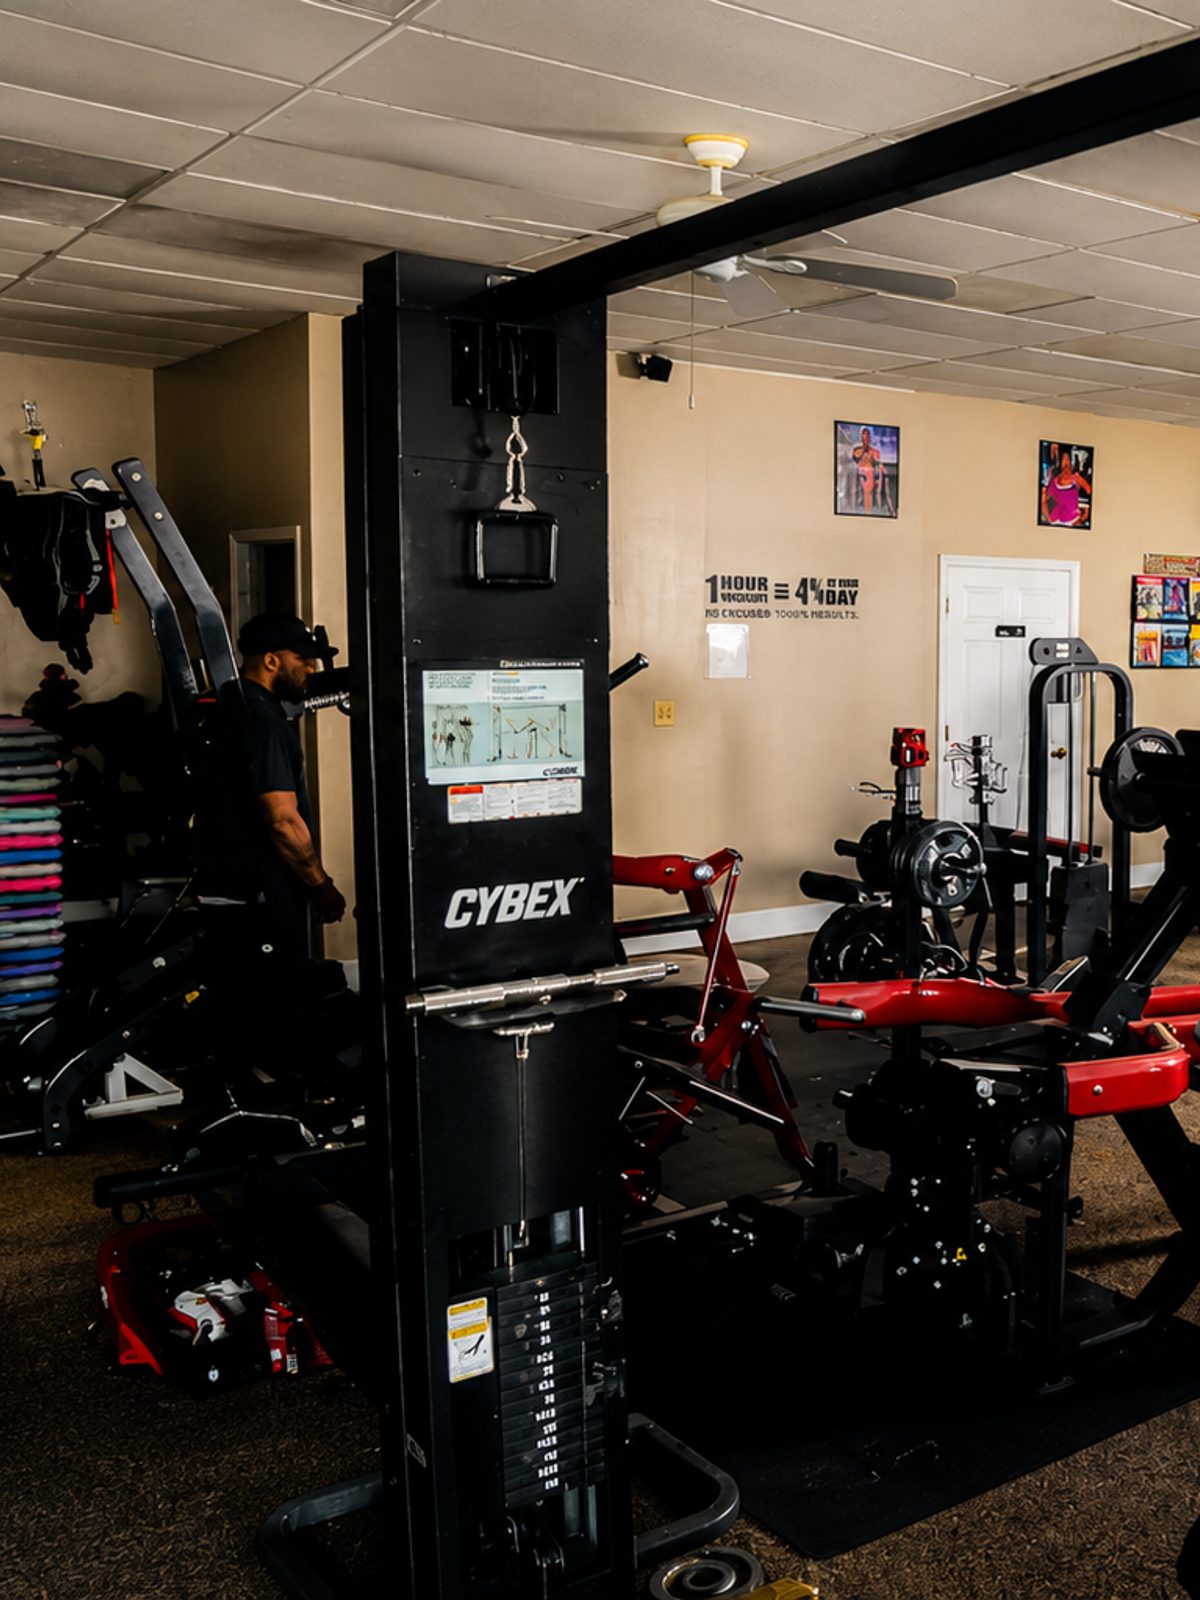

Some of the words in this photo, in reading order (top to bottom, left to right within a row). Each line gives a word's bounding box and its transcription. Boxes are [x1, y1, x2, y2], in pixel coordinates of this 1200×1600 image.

[705, 574, 718, 603] 1
[720, 575, 769, 591] HOUR
[826, 589, 859, 606] DAY
[444, 877, 579, 929] CYBEX
